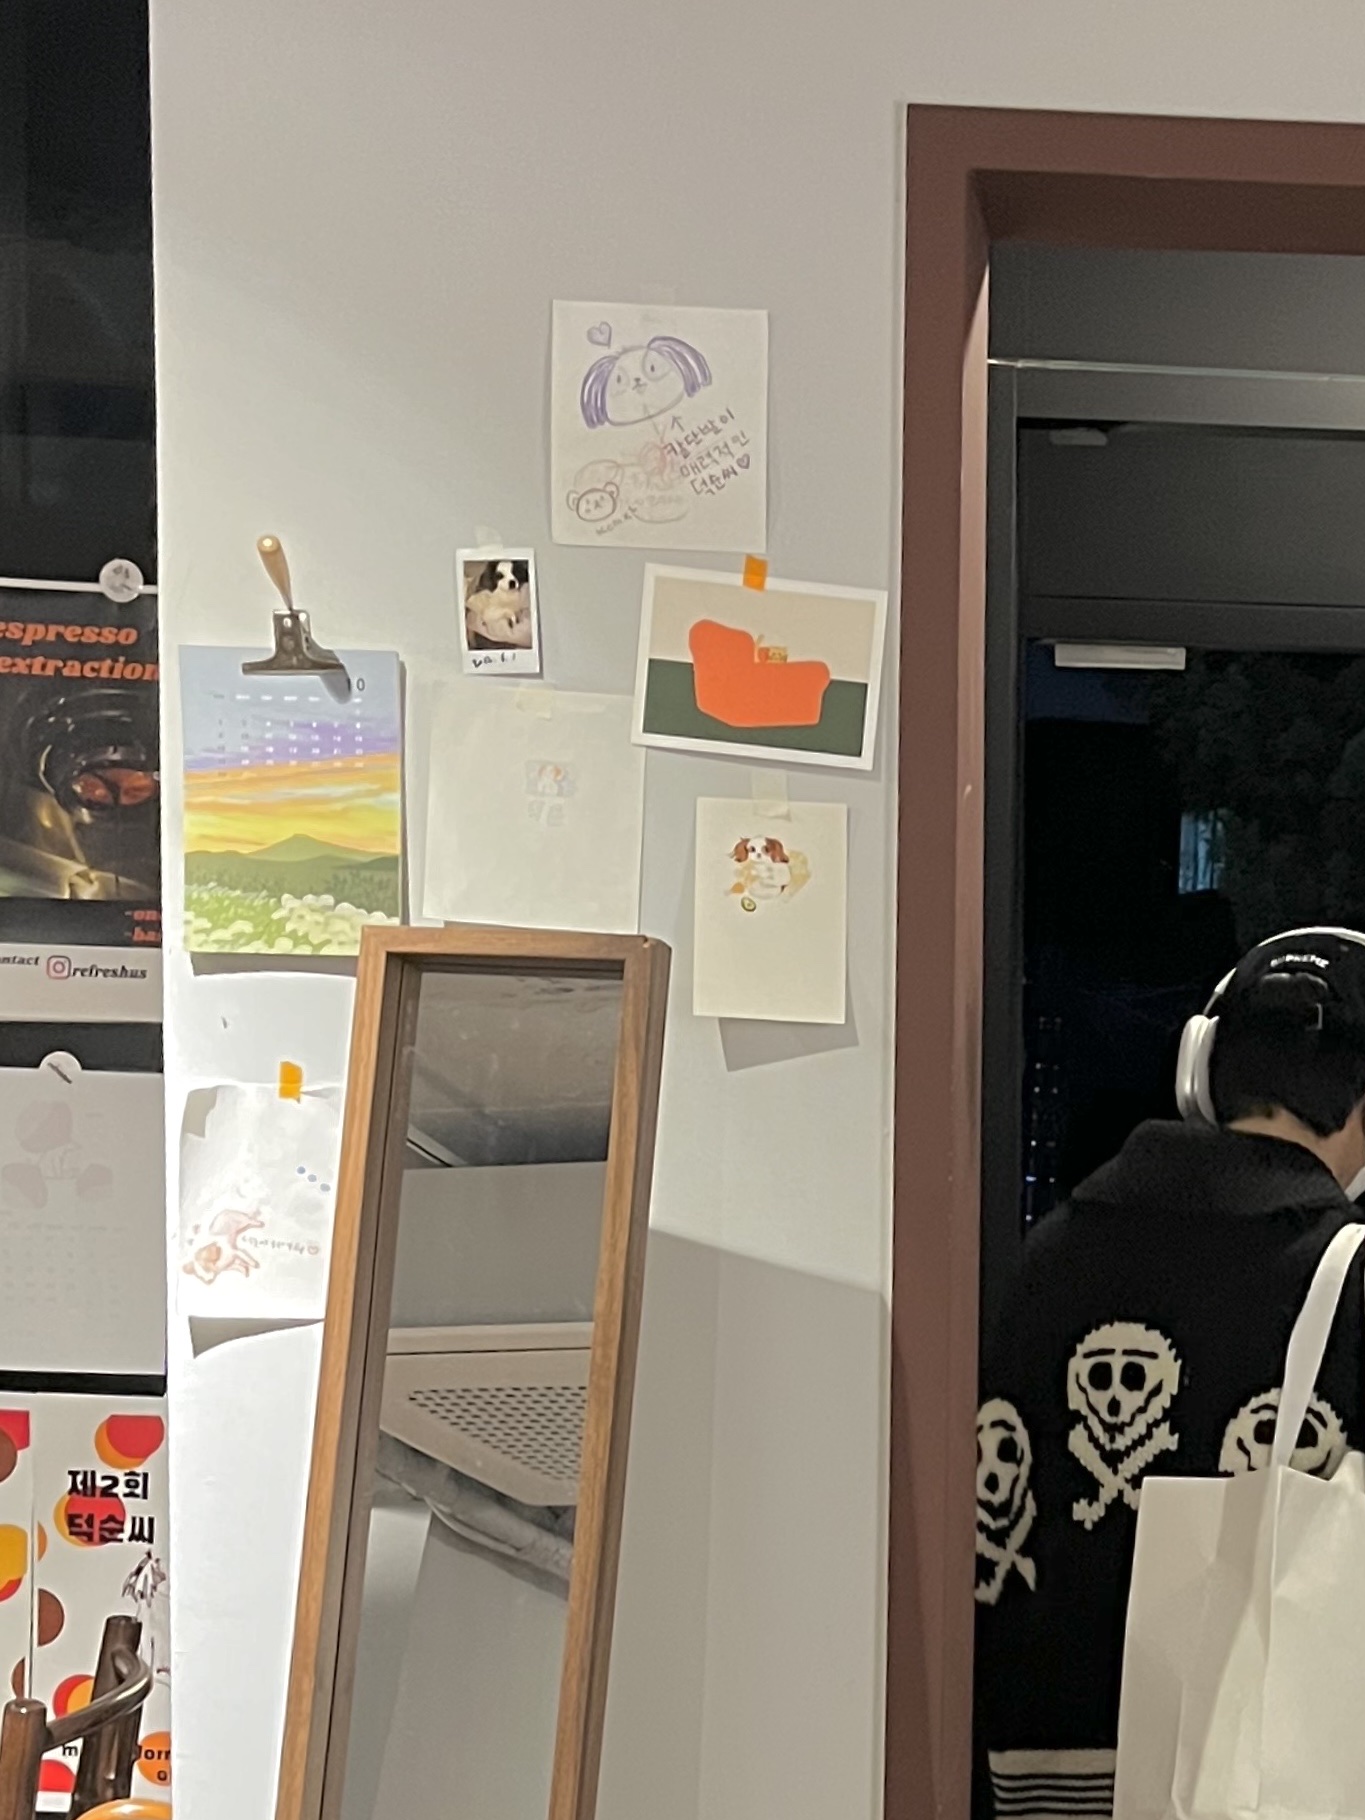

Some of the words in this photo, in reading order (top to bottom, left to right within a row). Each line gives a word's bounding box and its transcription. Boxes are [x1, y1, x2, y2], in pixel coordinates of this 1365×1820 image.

[72, 964, 148, 979] refreshus
[67, 1470, 149, 1500] 제2회
[67, 1513, 155, 1544] 덕순씨
